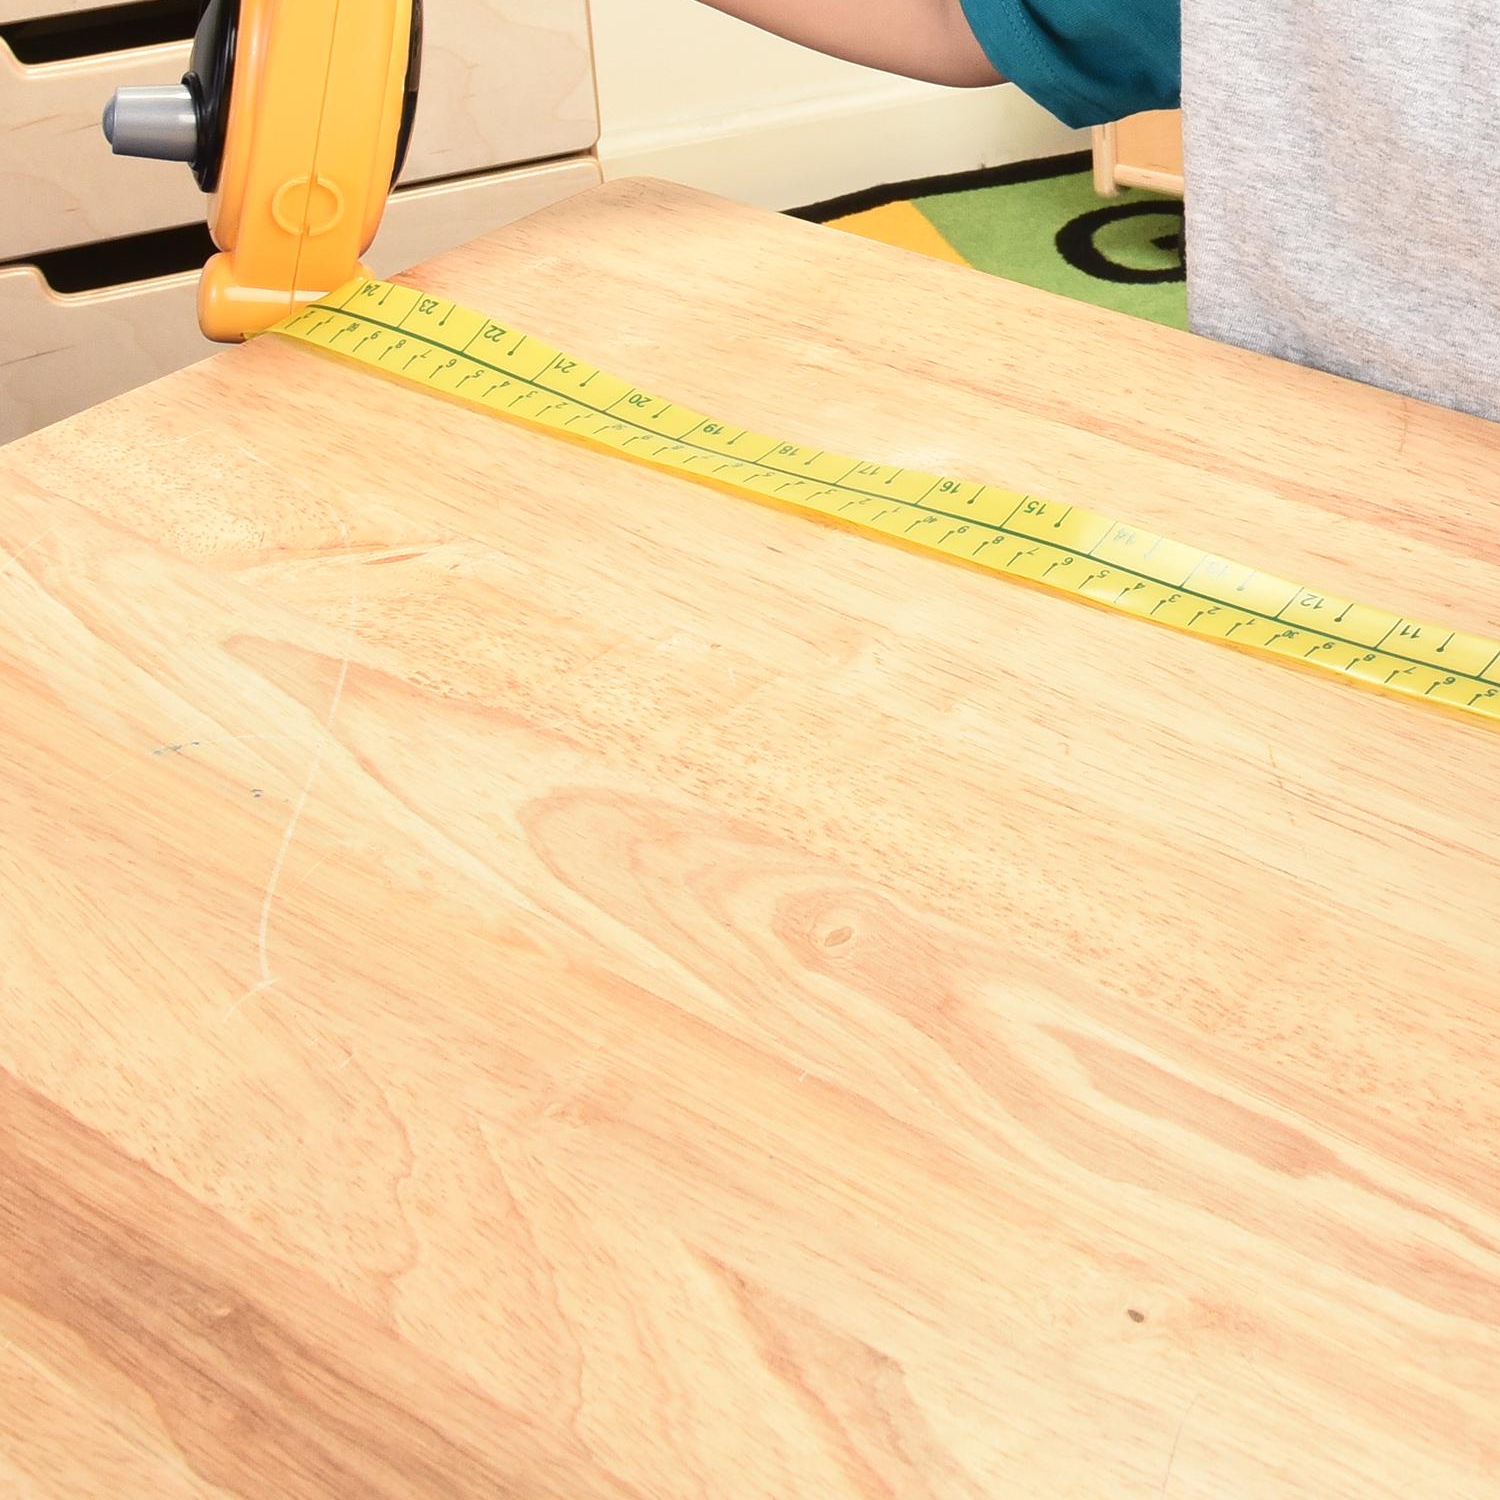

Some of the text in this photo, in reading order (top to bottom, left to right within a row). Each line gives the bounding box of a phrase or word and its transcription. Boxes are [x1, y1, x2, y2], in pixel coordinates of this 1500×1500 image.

[419, 299, 438, 315] 23
[484, 325, 507, 342] 22
[554, 358, 577, 373] 21
[628, 392, 652, 408] 20
[703, 423, 722, 436] 19
[940, 481, 960, 494] 16
[1024, 501, 1047, 516] 15
[1300, 593, 1324, 609] 12
[1400, 624, 1422, 639] 11
